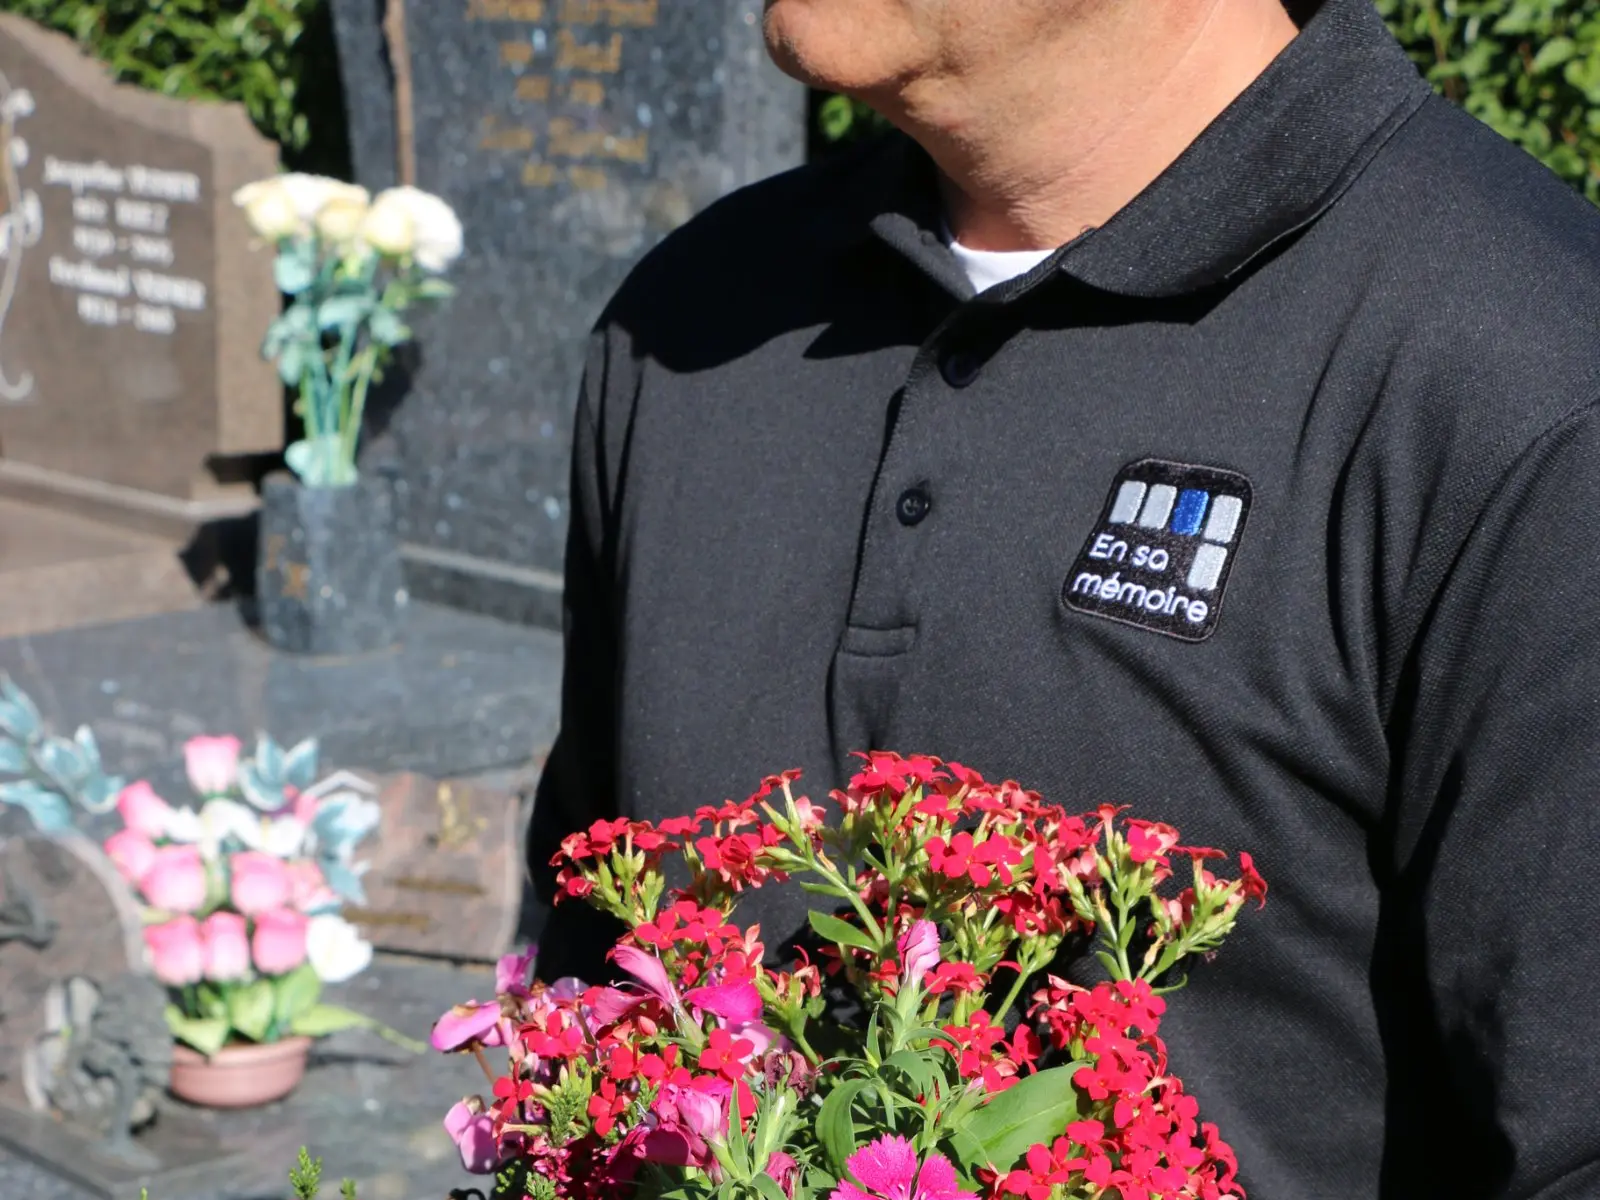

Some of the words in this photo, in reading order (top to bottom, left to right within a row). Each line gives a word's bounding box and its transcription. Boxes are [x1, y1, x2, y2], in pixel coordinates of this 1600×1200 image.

[1089, 533, 1128, 561] En
[1132, 545, 1170, 571] sa
[1073, 572, 1208, 622] mémoire
